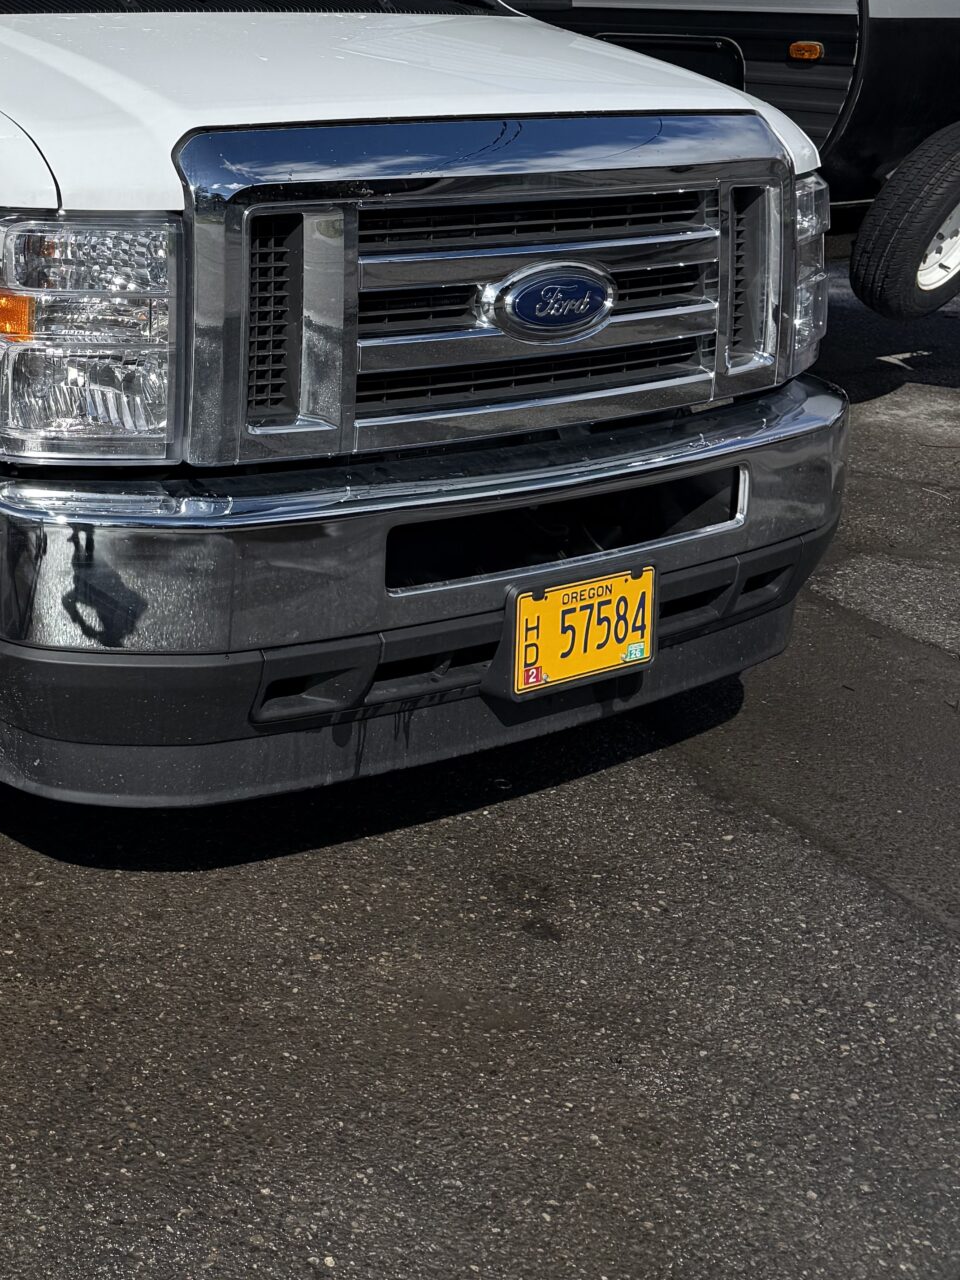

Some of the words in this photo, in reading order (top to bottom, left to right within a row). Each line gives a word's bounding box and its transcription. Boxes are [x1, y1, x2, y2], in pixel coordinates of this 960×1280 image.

[535, 284, 592, 318] Ford
[561, 584, 613, 606] OREGON
[560, 591, 647, 659] 57584
[528, 669, 537, 683] 2
